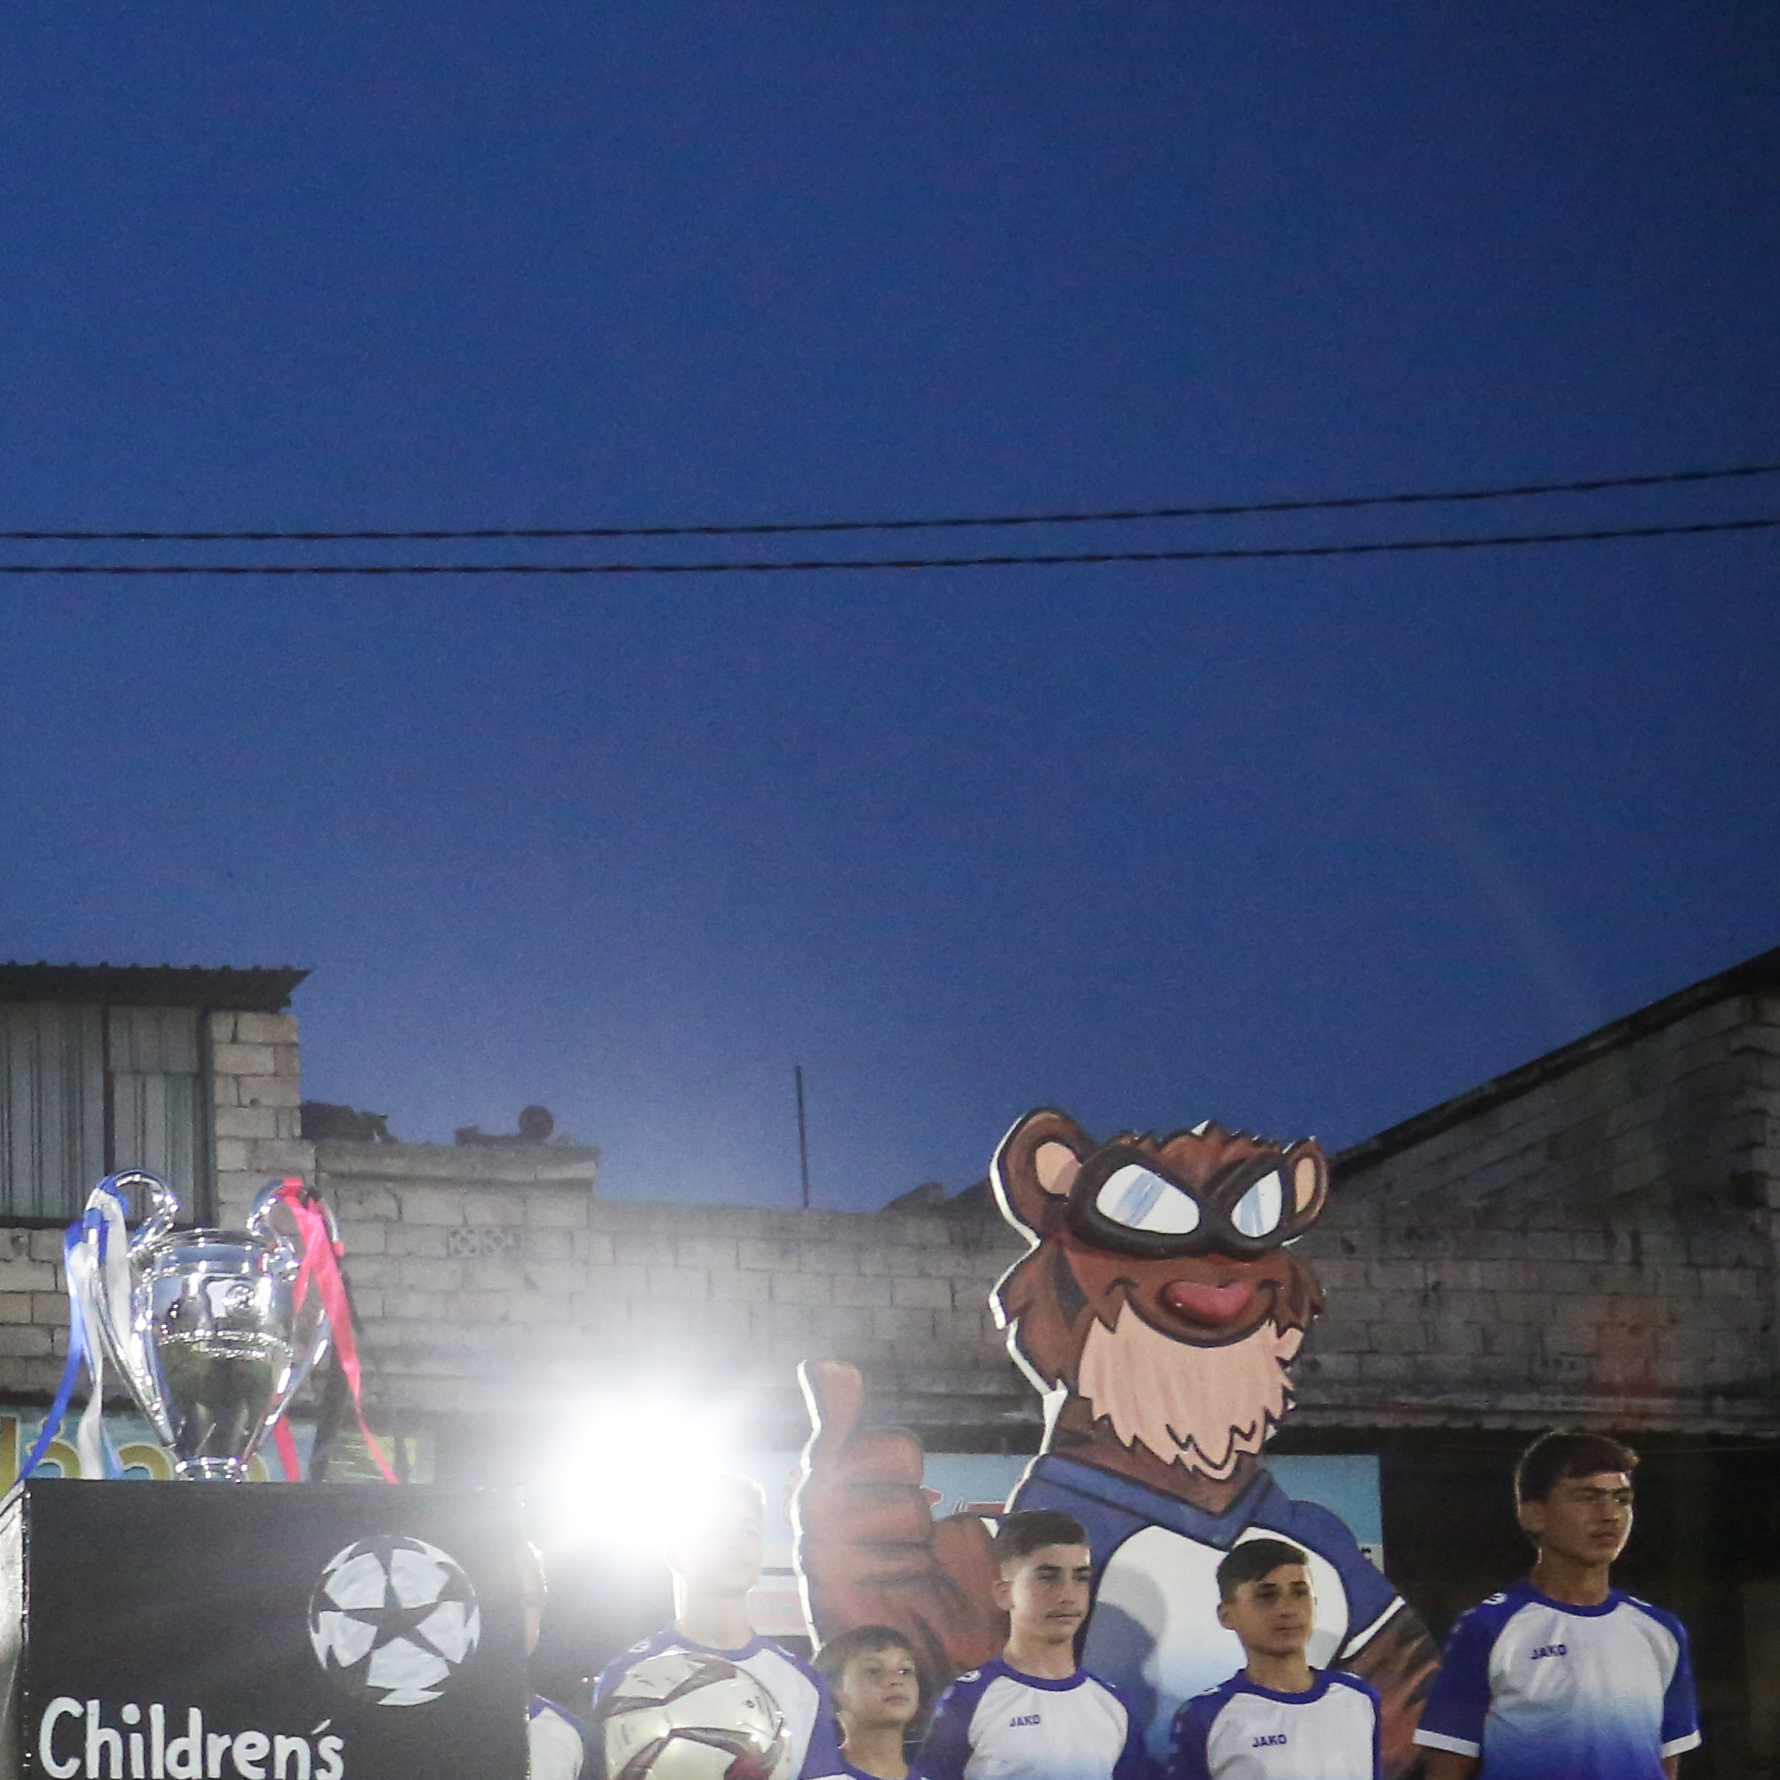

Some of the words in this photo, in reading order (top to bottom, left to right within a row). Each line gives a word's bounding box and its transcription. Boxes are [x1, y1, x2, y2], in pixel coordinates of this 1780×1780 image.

[1531, 1644, 1567, 1660] JAKO
[1009, 1714, 1041, 1728] JAKO
[1252, 1734, 1288, 1748] JAKO
